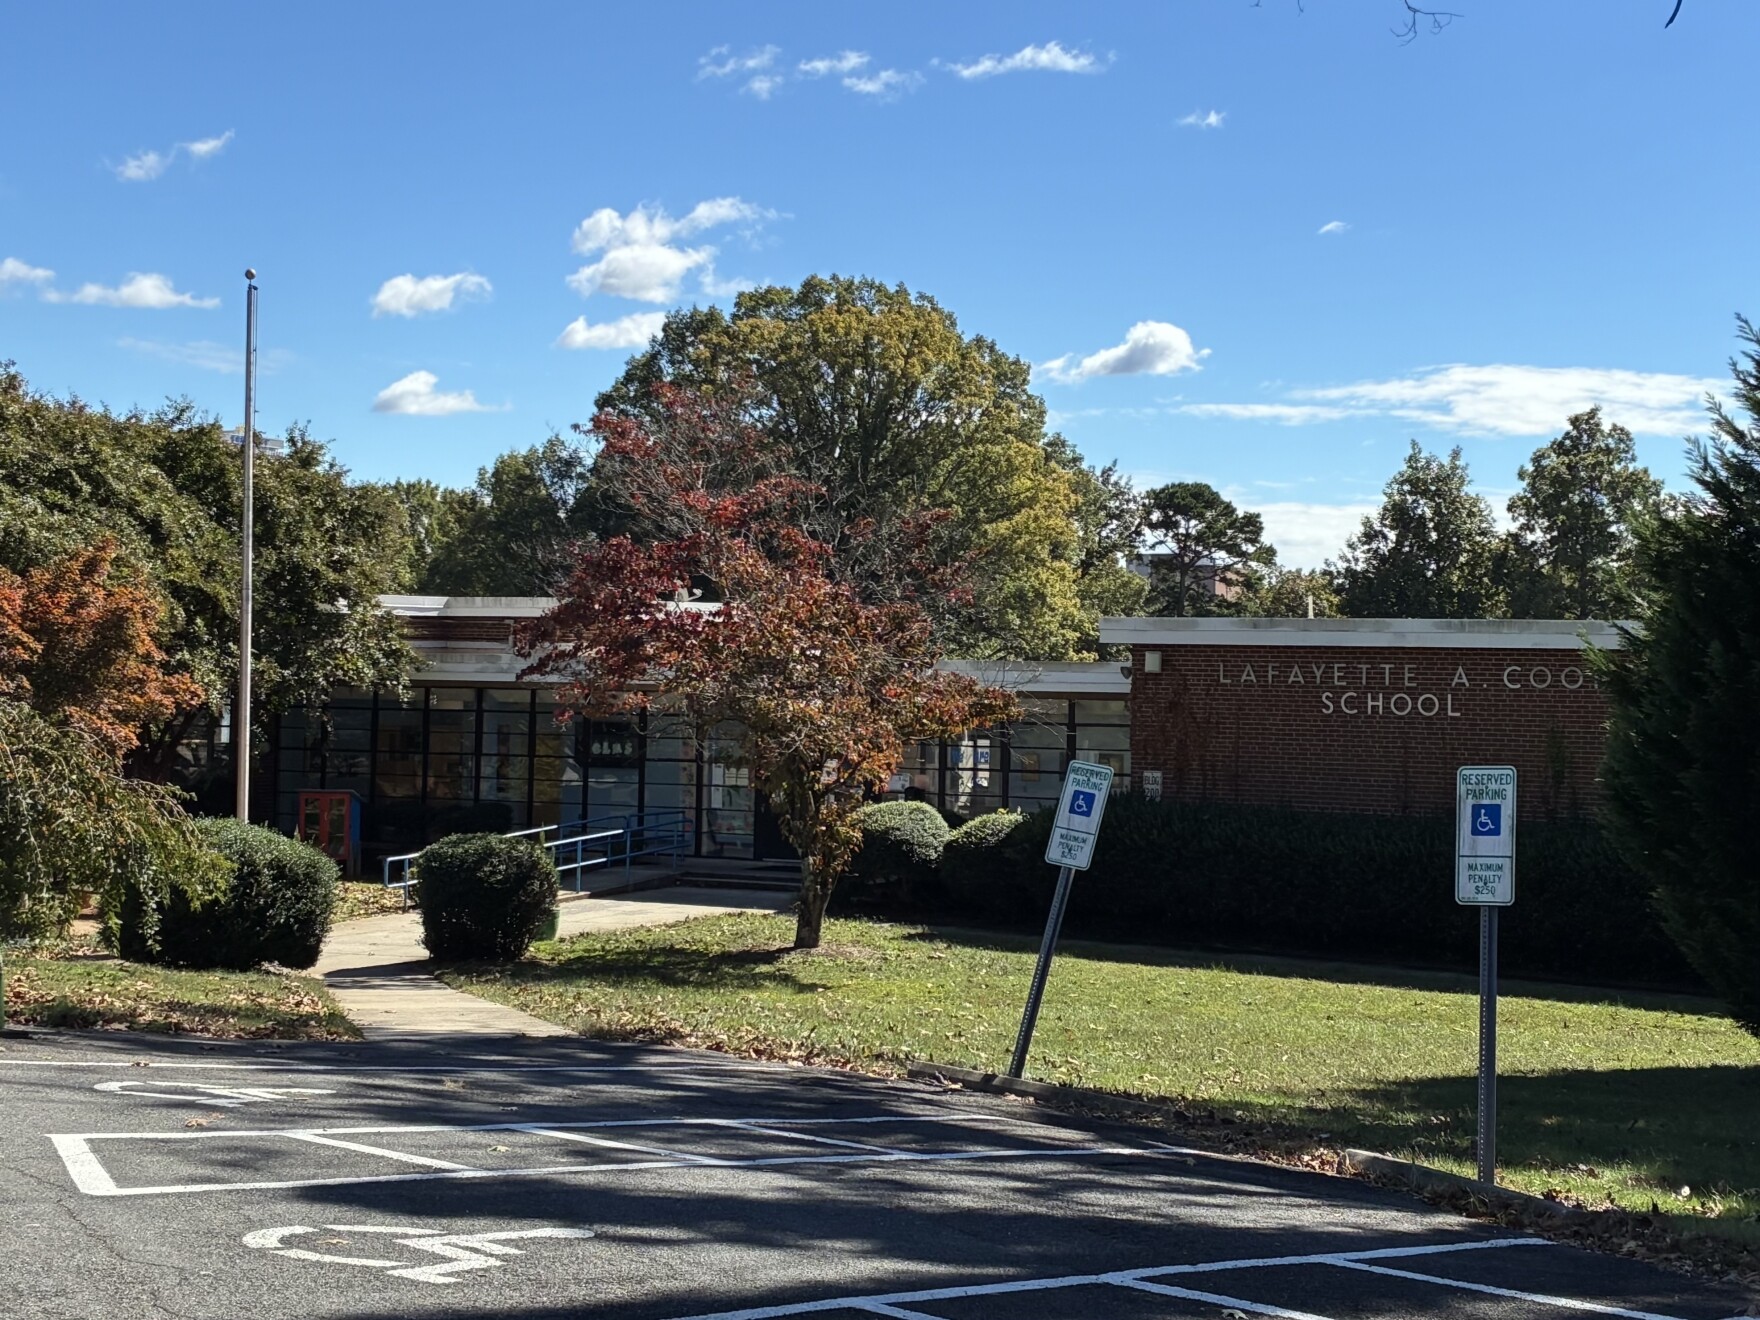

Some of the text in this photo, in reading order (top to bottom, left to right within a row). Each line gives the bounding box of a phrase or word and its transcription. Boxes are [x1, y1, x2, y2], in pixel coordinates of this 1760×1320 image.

[1218, 663, 1417, 687] LAFAYETTE
[1503, 666, 1599, 690] COO
[1321, 692, 1461, 717] SCHOOL
[1070, 766, 1110, 782] RESERVED
[1462, 773, 1512, 786] RESERVED
[1071, 777, 1103, 792] PARKING
[1465, 788, 1507, 800] PARKING
[1059, 832, 1088, 845] MAXIMUM
[1057, 842, 1085, 853] PENALTY
[1060, 850, 1078, 861] $250
[1467, 863, 1503, 873] MAXIMUM
[1468, 874, 1502, 884] PENALTY
[1474, 885, 1496, 895] $250
